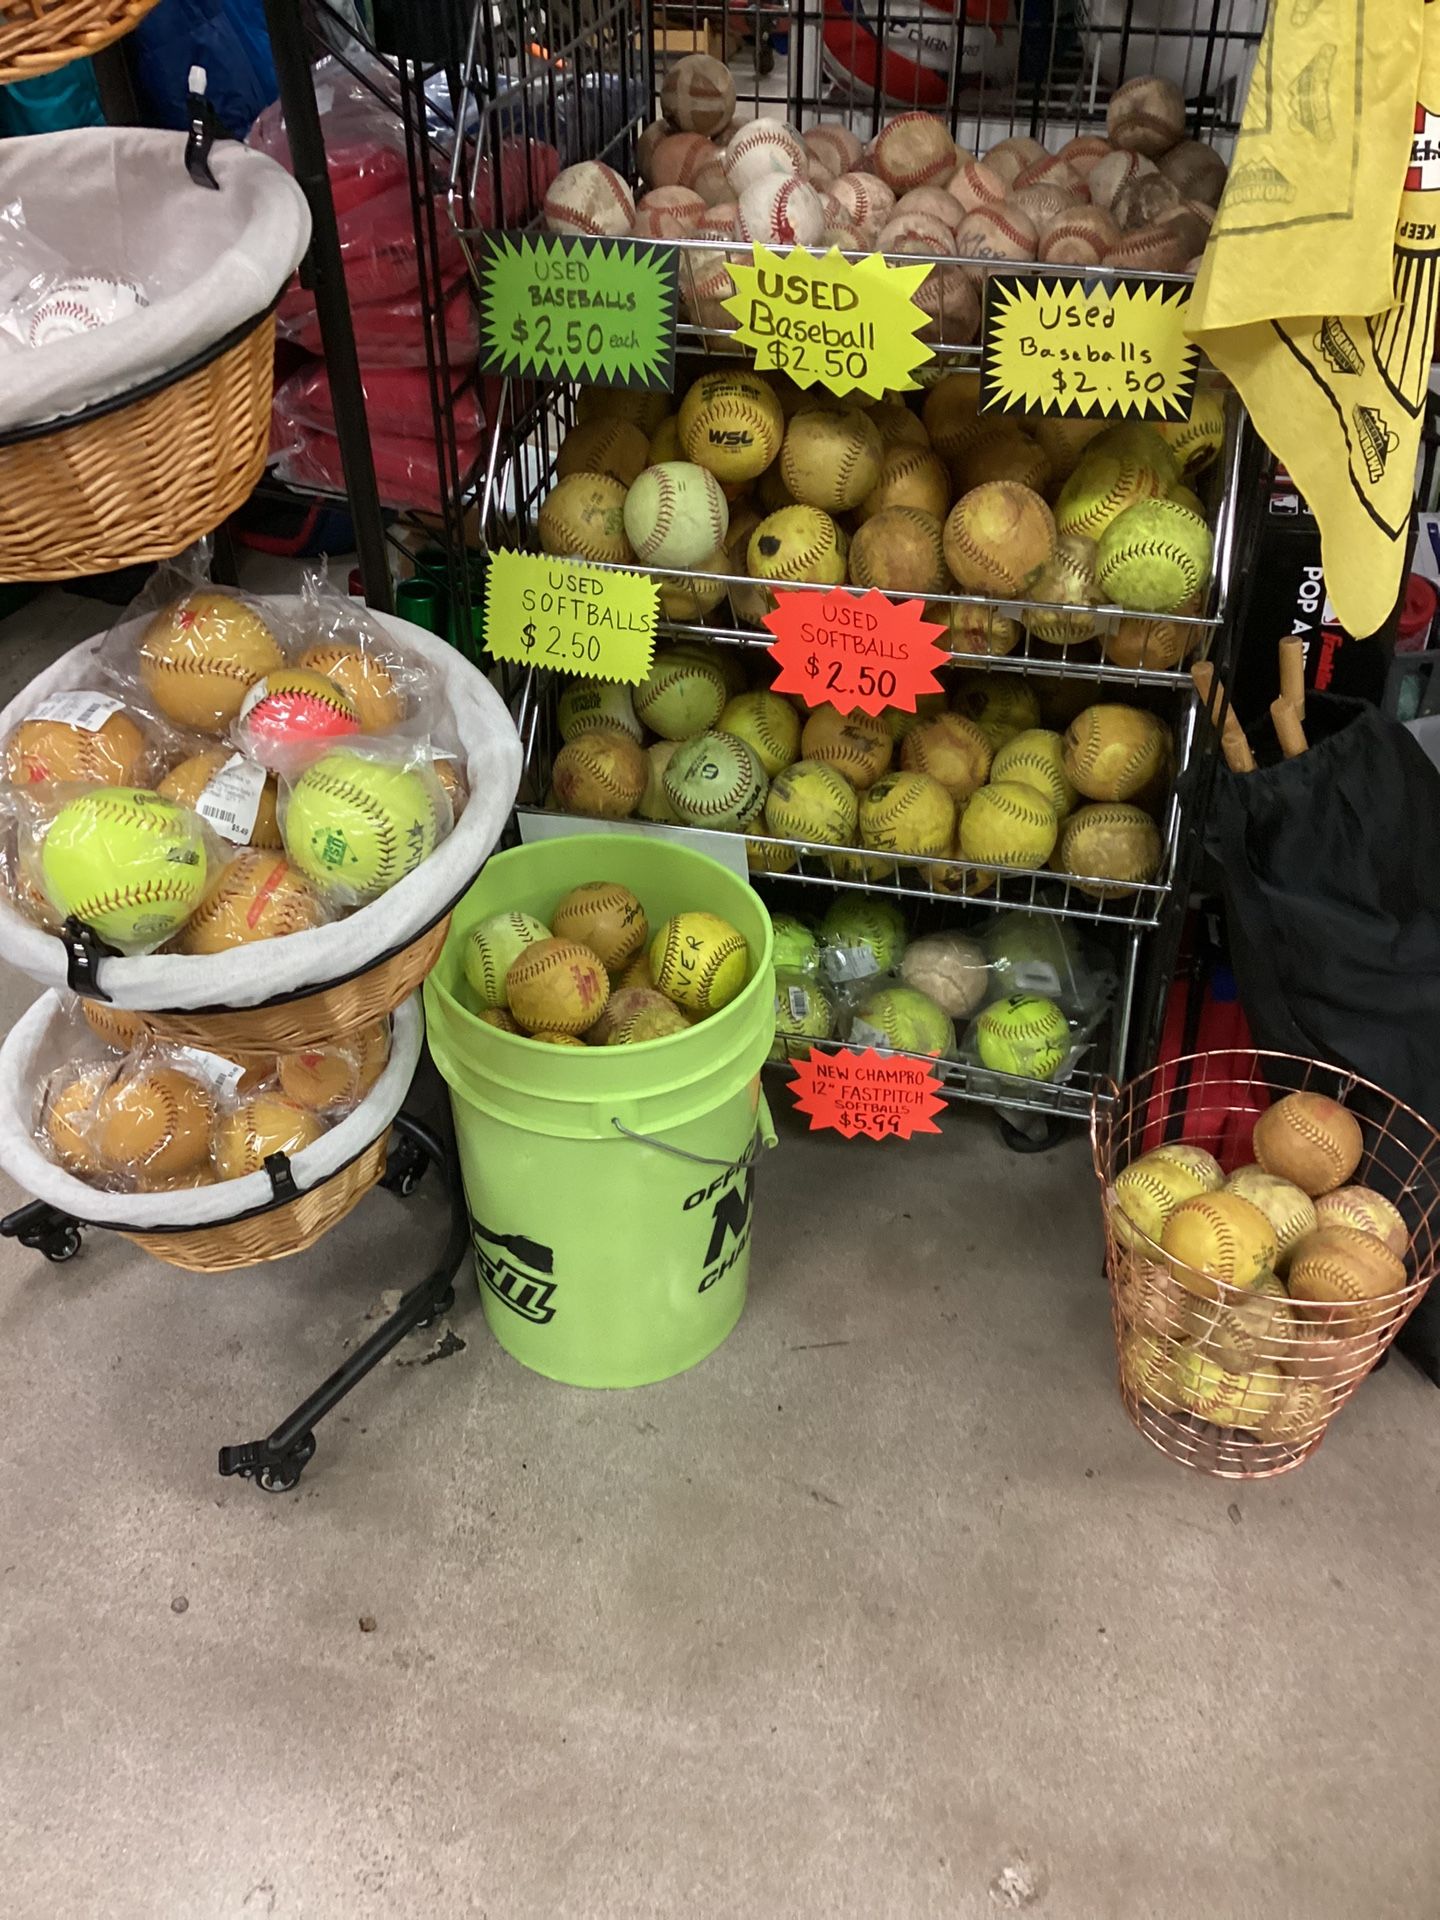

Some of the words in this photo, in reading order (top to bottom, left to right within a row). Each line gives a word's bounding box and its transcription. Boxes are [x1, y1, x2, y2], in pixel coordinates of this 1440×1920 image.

[534, 260, 590, 283] USED
[528, 285, 637, 312] BASEBALLS
[757, 269, 860, 311] USED
[749, 299, 874, 350] Baseball
[1039, 305, 1115, 329] Used
[511, 312, 604, 356] $2.50
[609, 330, 640, 349] each
[767, 339, 867, 378] $2.50
[1019, 336, 1152, 364] Baseballs
[708, 428, 756, 446] WSL
[548, 571, 604, 595] USED
[1298, 566, 1324, 613] POP
[522, 589, 650, 632] SOFTBALLS
[823, 604, 878, 631] USED
[520, 616, 600, 661] $2.50
[1291, 618, 1313, 635] A
[801, 623, 909, 660] SOFTBALLS
[805, 652, 897, 698] $2.50
[231, 823, 249, 836] $5.49
[324, 835, 346, 866] USA
[817, 1064, 849, 1080] NEW
[855, 1068, 925, 1086] CHAMPRO
[835, 1100, 910, 1115] SOFTBALLS
[842, 1085, 924, 1105] FASTPITCH
[839, 1111, 902, 1133] $5.99
